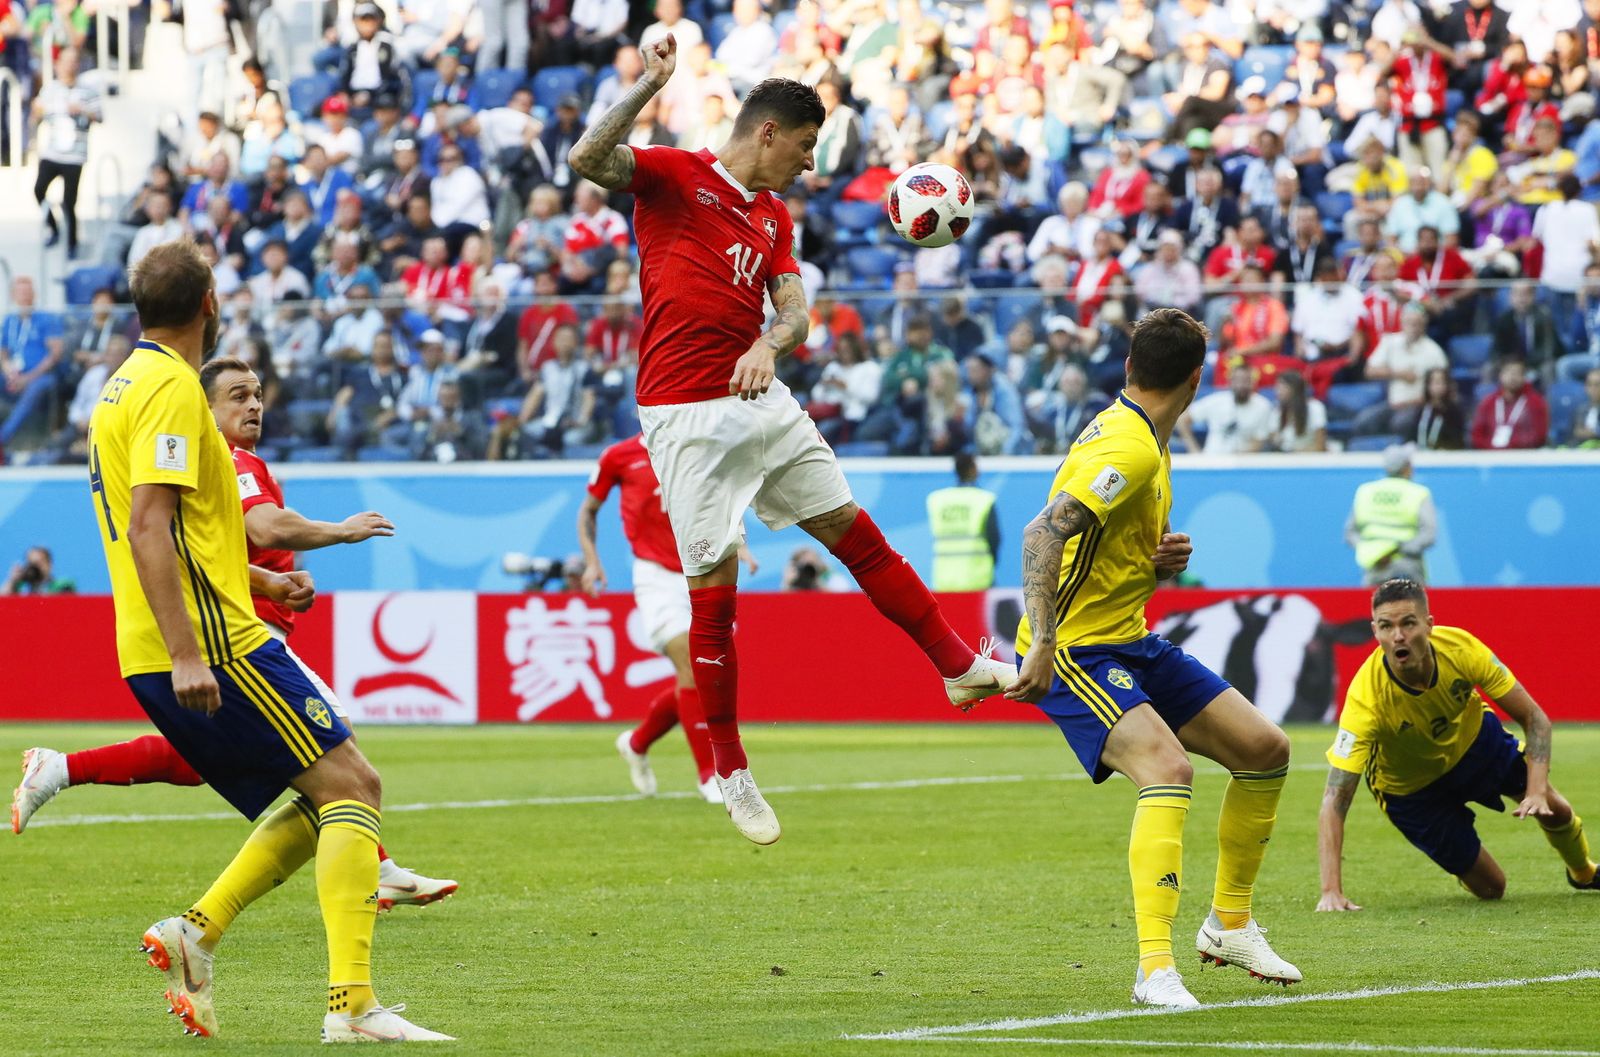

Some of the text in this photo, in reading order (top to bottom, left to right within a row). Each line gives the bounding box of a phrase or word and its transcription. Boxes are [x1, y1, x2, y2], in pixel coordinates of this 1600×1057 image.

[726, 242, 763, 287] 14
[88, 427, 118, 542] 4
[1431, 717, 1449, 739] 2
